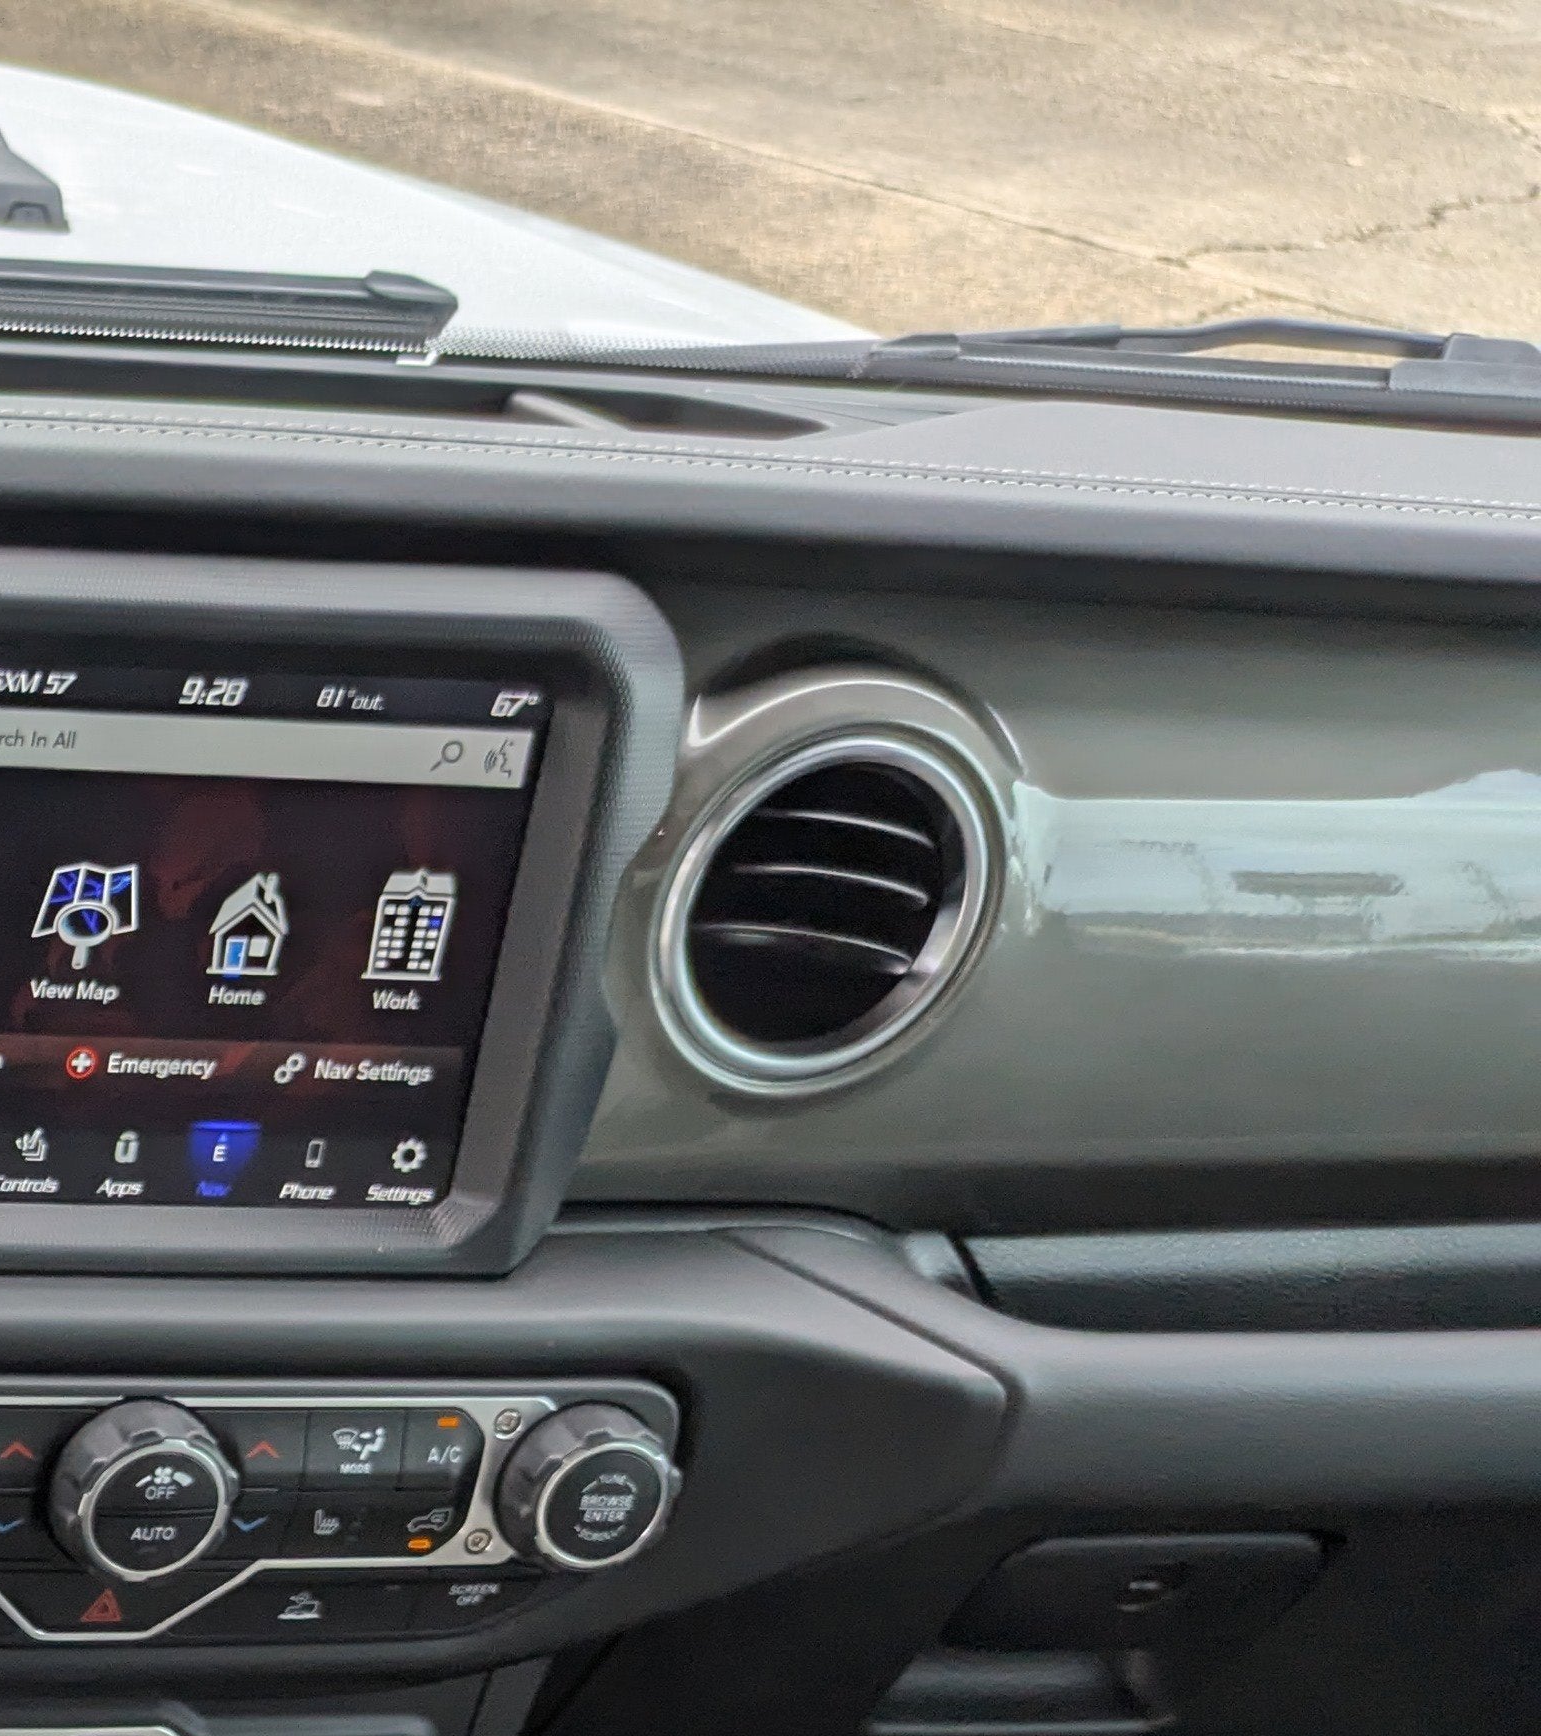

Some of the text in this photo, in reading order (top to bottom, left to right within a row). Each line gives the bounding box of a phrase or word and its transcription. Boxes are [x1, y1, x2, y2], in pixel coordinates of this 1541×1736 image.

[43, 671, 79, 696] 57
[177, 675, 250, 708] 9:28
[30, 730, 48, 748] In
[52, 730, 79, 750] All
[29, 978, 121, 1005] View Map
[207, 985, 268, 1007] Home
[371, 988, 423, 1011] Work
[106, 1053, 218, 1080] Emergency
[313, 1059, 435, 1087] Nav Settings
[95, 1178, 145, 1199] Apps
[278, 1182, 337, 1201] Phone
[364, 1183, 437, 1206] Settings
[426, 1444, 462, 1465] A/C
[144, 1485, 178, 1501] OFF
[129, 1526, 179, 1542] AUTO
